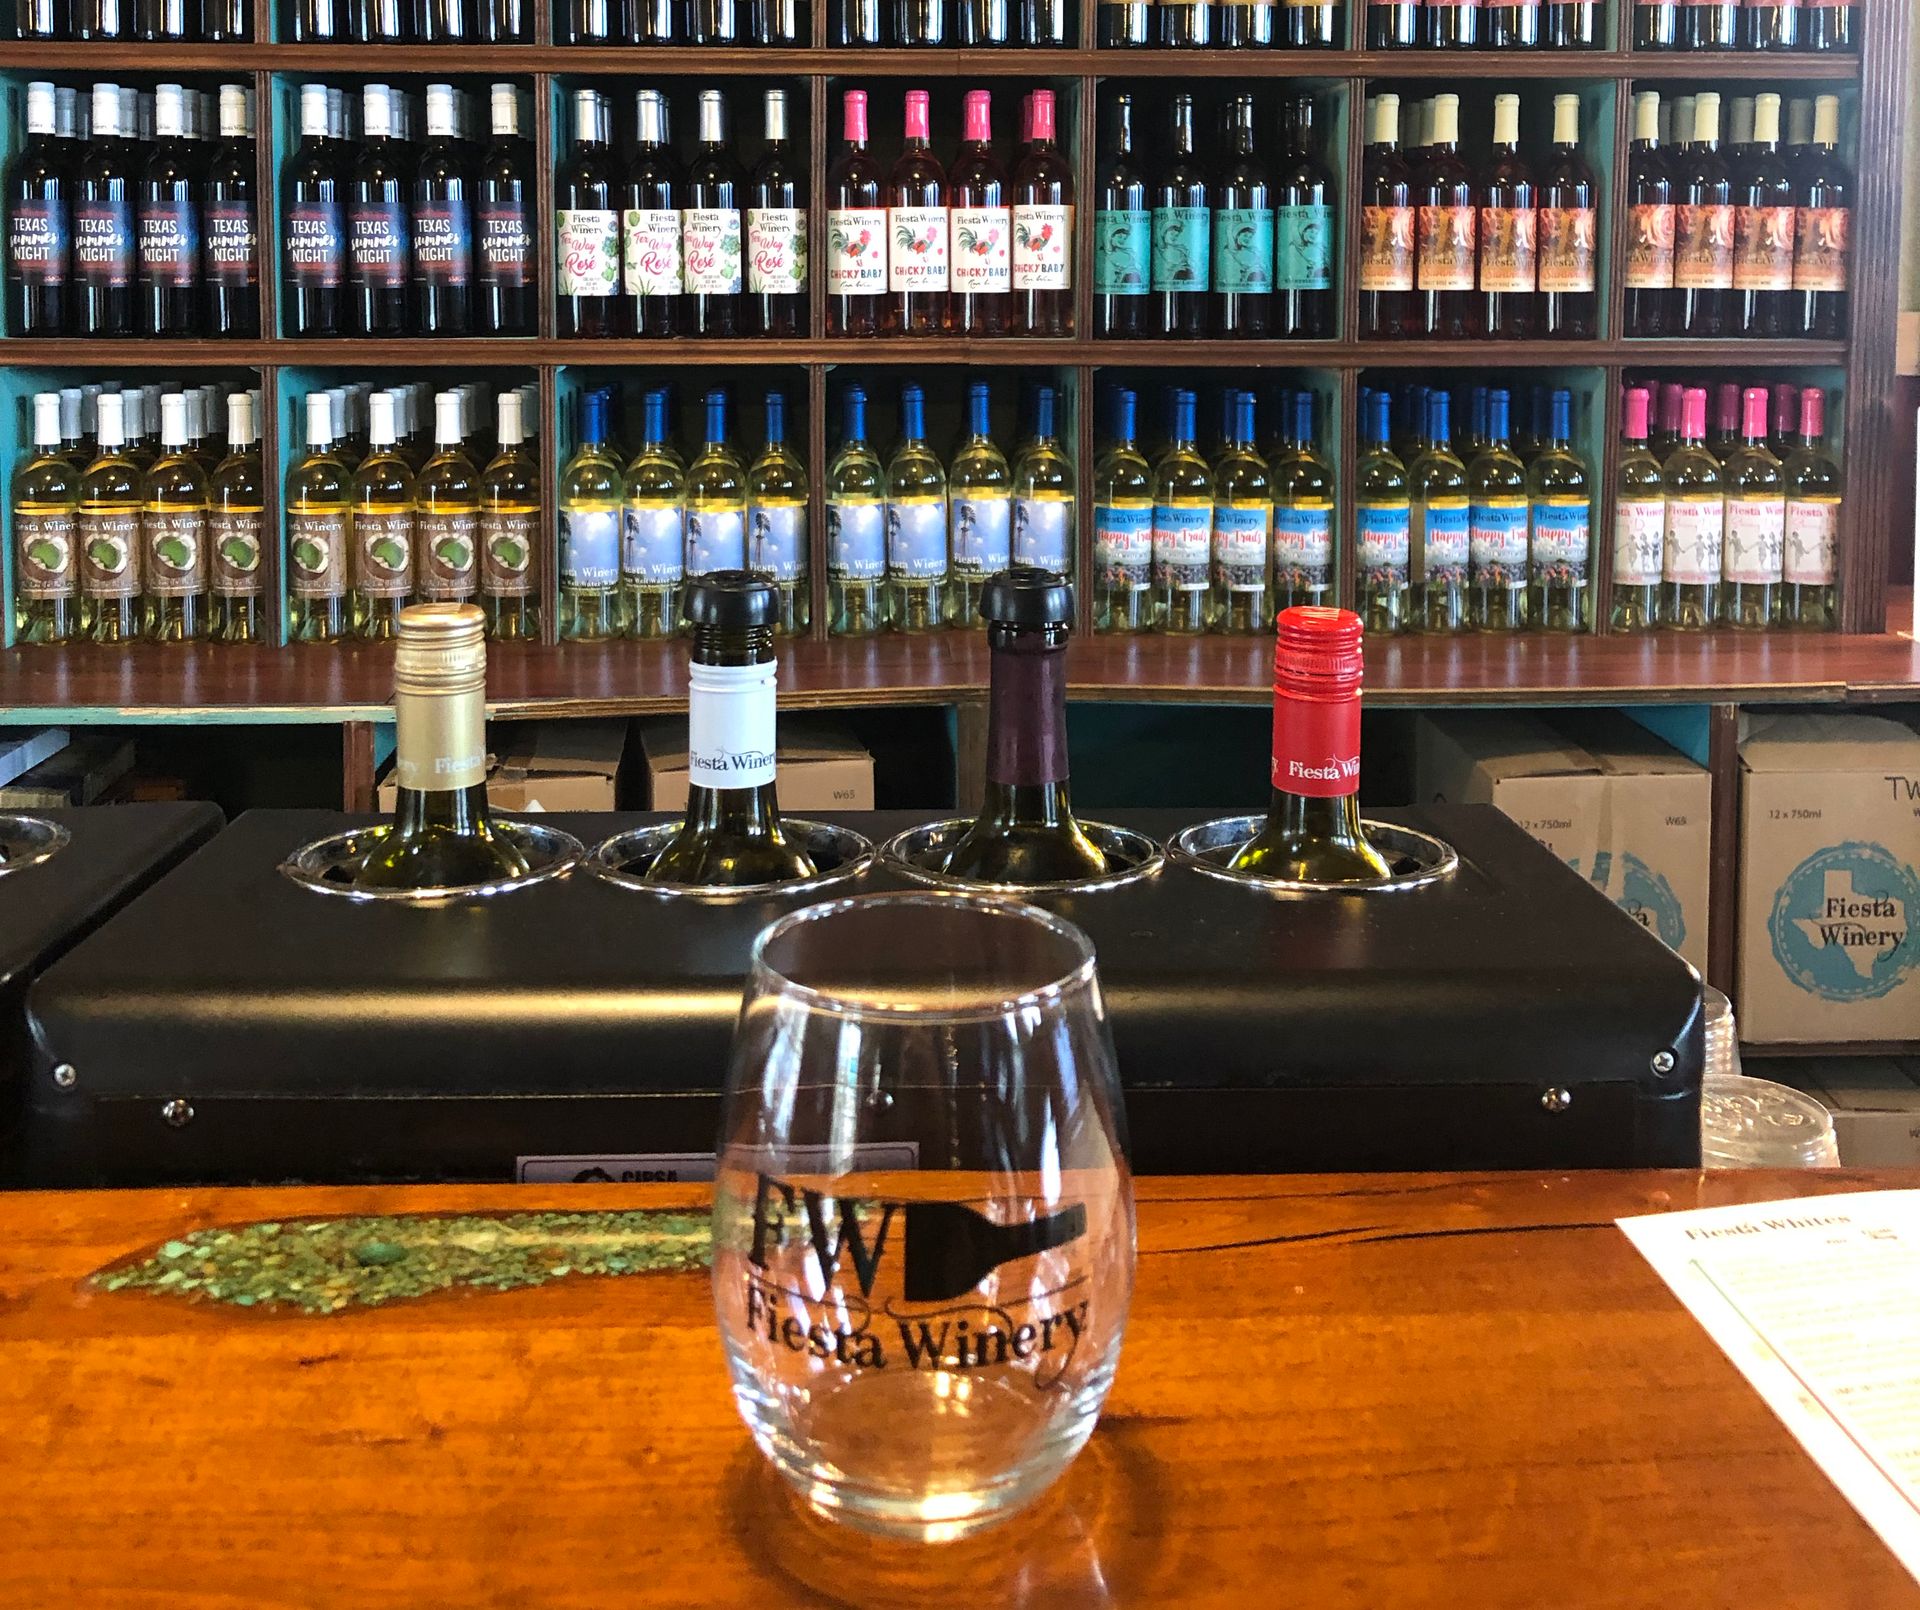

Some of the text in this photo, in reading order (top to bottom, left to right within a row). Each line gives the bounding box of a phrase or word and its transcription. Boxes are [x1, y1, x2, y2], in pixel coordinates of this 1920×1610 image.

[14, 218, 48, 231] TEXAS
[572, 214, 601, 223] Fiesta
[650, 213, 676, 222] Fiesta
[692, 213, 719, 222] Fiesta
[761, 213, 788, 222] Fiesta
[830, 217, 853, 227] Fiesta
[895, 214, 919, 224] Fiesta
[957, 215, 981, 225] Fiesta
[80, 219, 114, 232] TEXAS
[144, 219, 178, 233] TEXAS
[213, 220, 249, 233] TEXAS
[292, 220, 327, 234] TEXAS
[355, 220, 389, 234] TEXAS
[417, 219, 450, 233] TEXAS
[487, 220, 523, 234] TEXAS
[571, 223, 603, 235] Winery
[648, 222, 678, 237] Winery
[691, 222, 722, 237] Winery
[759, 222, 791, 233] Winery
[14, 247, 50, 260] NIGHT
[80, 248, 116, 262] NIGHT
[144, 248, 180, 262] NIGHT
[214, 248, 251, 262] NIGHT
[292, 249, 329, 263] NIGHT
[356, 249, 392, 263] NIGHT
[418, 247, 453, 261] NIGHT
[488, 248, 526, 262] NIGHT
[565, 251, 596, 276] Rosé
[640, 251, 674, 276] Rosé
[687, 250, 716, 275] Rosé
[755, 250, 785, 275] Rosé
[1041, 263, 1065, 272] BABY
[860, 269, 883, 278] BABY
[926, 267, 947, 277] BABY
[988, 267, 1009, 277] BABY
[1668, 506, 1698, 516] Fiesta
[1729, 505, 1760, 516] Fiesta
[1790, 506, 1823, 517] Fiesta
[304, 521, 344, 532] Winery
[1098, 530, 1129, 550] Happy
[1363, 529, 1397, 550] Happy
[1432, 529, 1463, 550] Happy
[1471, 527, 1504, 549] Happy
[1537, 526, 1571, 549] Happy
[690, 750, 729, 771] Fiesta
[1288, 760, 1341, 780] Fiesta
[833, 789, 855, 800] W65
[1769, 810, 1779, 819] 12
[1791, 809, 1822, 819] 750ml
[1541, 819, 1572, 829] 750ml
[1825, 896, 1897, 919] Fiesta
[1820, 924, 1904, 955] Winery
[746, 1284, 1091, 1389] Fiesta Winery
